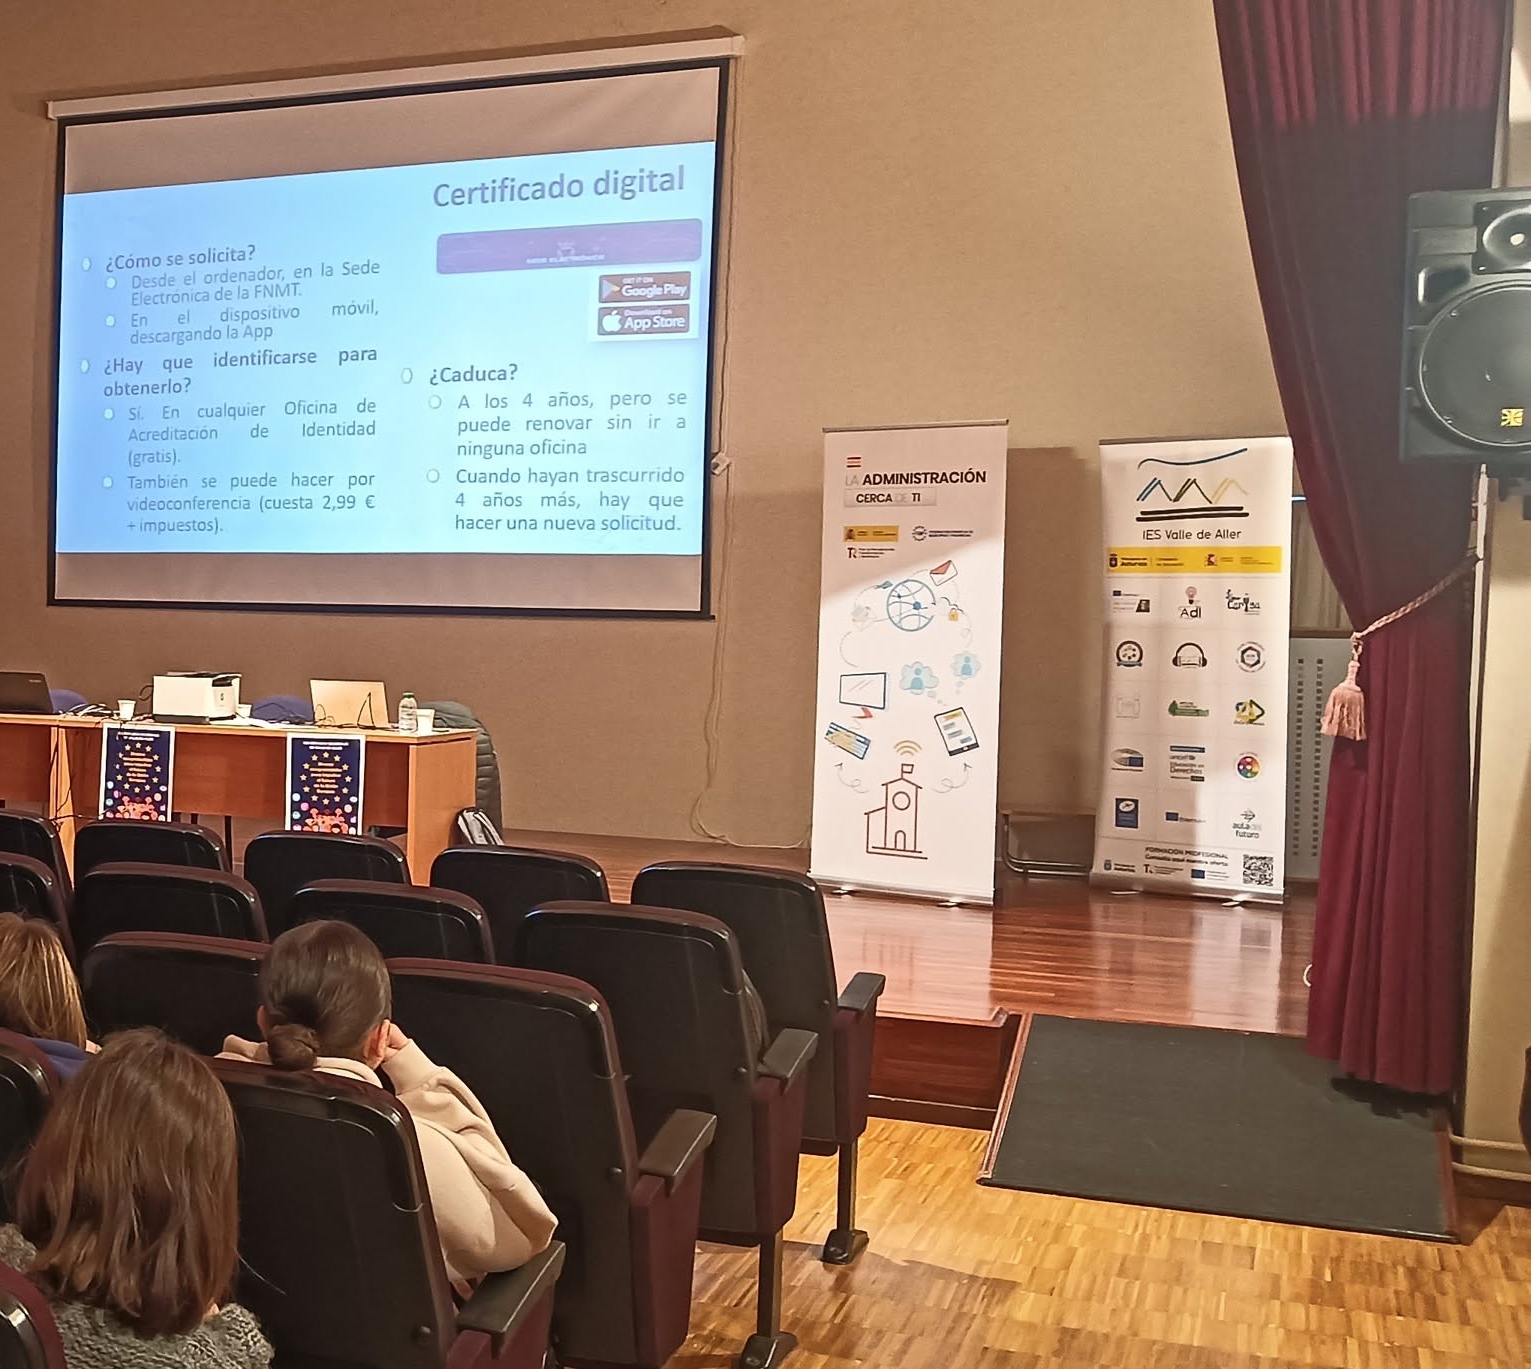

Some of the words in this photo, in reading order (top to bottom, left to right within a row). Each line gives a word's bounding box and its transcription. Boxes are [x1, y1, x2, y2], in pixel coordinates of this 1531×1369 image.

[434, 173, 584, 207] Certificado
[593, 165, 684, 200] digital
[106, 254, 161, 273] ¿Cómo
[166, 254, 183, 267] se
[189, 245, 255, 265] solicita?
[132, 273, 175, 289] Desde
[184, 271, 195, 285] el
[204, 267, 285, 285] ordenador,
[294, 264, 312, 278] en
[321, 262, 334, 277] la
[342, 259, 380, 275] Sede
[132, 290, 209, 306] Electrónica
[214, 287, 232, 300] de
[237, 285, 249, 300] la
[255, 282, 302, 298] FNMT.
[622, 285, 662, 298] Google
[664, 283, 687, 296] Play
[132, 314, 147, 327] En
[178, 310, 190, 324] el
[220, 305, 300, 324] dispositivo
[332, 300, 378, 316] móvil,
[624, 317, 651, 331] App
[653, 316, 685, 327] Store
[130, 326, 221, 345] descargando
[227, 325, 238, 339] la
[243, 323, 273, 340] App
[104, 359, 143, 375] ¿Hay
[163, 355, 193, 373] que
[214, 349, 317, 368] identificarse
[339, 348, 377, 365] para
[430, 364, 518, 386] ¿Caduca?
[104, 377, 191, 396] obtenerlo?
[129, 407, 144, 420] Sí.
[163, 406, 179, 419] En
[198, 402, 266, 420] cualquier
[285, 400, 337, 416] Oficina
[357, 398, 376, 413] de
[458, 395, 470, 409] A
[486, 394, 508, 408] los
[523, 393, 532, 407] 4
[548, 392, 594, 409] años,
[610, 392, 652, 409] pero
[668, 393, 687, 404] se
[129, 426, 218, 442] Acreditación
[250, 424, 269, 438] de
[302, 420, 376, 437] Identidad
[458, 417, 510, 436] puede
[526, 417, 593, 430] renovar
[608, 415, 632, 429] sin
[648, 414, 661, 429] ir
[676, 417, 686, 429] a
[129, 450, 181, 467] (gratis).
[457, 441, 524, 459] ninguna
[530, 439, 587, 455] oficina
[128, 475, 188, 489] También
[202, 477, 217, 487] se
[231, 472, 277, 491] puede
[291, 472, 334, 487] hacer
[349, 475, 375, 489] por
[456, 468, 520, 483] Cuando
[528, 467, 579, 487] hayan
[587, 467, 684, 483] trascurrido
[863, 468, 986, 485] ADMINISTRACIÓN
[128, 497, 250, 512] videoconferencia
[260, 496, 313, 512] (cuesta
[323, 495, 356, 512] 2,99
[365, 495, 375, 509] €
[455, 493, 465, 506] 4
[483, 492, 522, 507] años
[541, 491, 581, 509] más,
[600, 492, 630, 510] hay
[649, 494, 683, 511] que
[856, 494, 893, 503] CERCA
[912, 493, 920, 502] TI
[140, 518, 223, 534] impuestos).
[456, 515, 501, 530] hacer
[507, 519, 538, 530] una
[544, 519, 595, 530] nueva
[601, 515, 681, 530] solicitud.
[1143, 530, 1161, 540] IES
[1165, 530, 1192, 540] Valle
[1197, 529, 1211, 540] de
[1215, 529, 1242, 539] Aller
[1236, 830, 1259, 838] futuro
